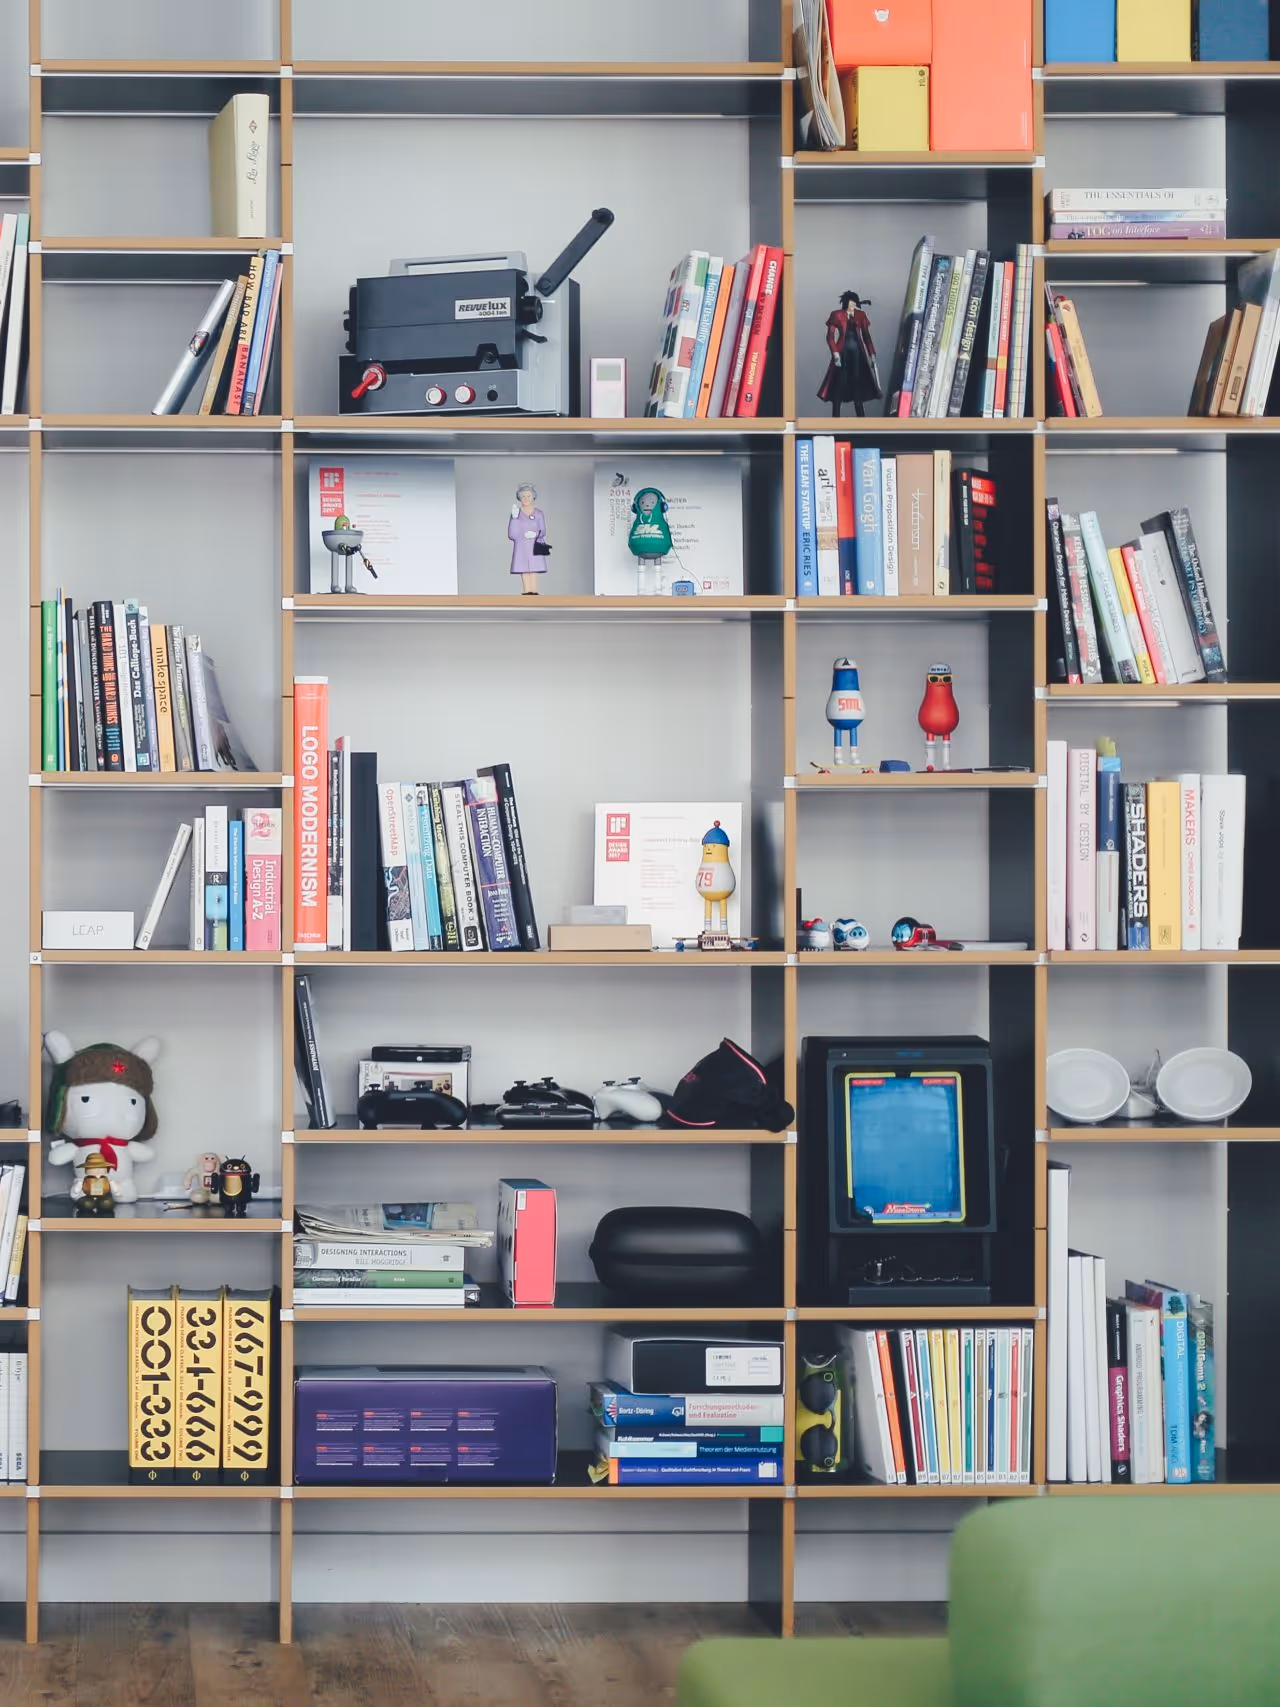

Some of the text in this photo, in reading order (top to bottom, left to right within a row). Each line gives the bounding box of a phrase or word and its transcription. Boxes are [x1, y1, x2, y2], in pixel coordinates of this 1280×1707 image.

[1084, 190, 1161, 199] THE ESSENTIALS
[246, 264, 258, 289] HOW
[765, 260, 777, 295] CHANGE
[947, 287, 958, 316] THINGS
[237, 322, 249, 342] ARE
[697, 278, 718, 343] Mobile Usability
[961, 297, 981, 351] icon design
[747, 363, 757, 385] BROWN
[609, 489, 631, 497] 2014
[818, 468, 835, 491] art
[860, 458, 878, 533] Van Gogh
[800, 444, 812, 576] THE LEAN STARTUP ERIC RIES
[884, 467, 896, 575] Value Proposition Design
[1052, 521, 1071, 635] Character Design Mobile Devices
[1187, 543, 1209, 615] The Oxford Handbook
[1187, 580, 1206, 634] PSYCHOLOGY
[90, 642, 98, 675] DUNGEON
[101, 633, 118, 724] HARD THING HARD THINGS
[127, 619, 142, 698] Das Calliope-Buch
[153, 647, 169, 713] make space
[301, 725, 318, 907] LOGO MODERNISM
[385, 788, 400, 856] OpenStreetMap
[432, 788, 445, 841] Sketching User
[476, 808, 492, 857] INTERACTION
[1079, 752, 1090, 861] DIGITAL BY DESIGN
[1185, 789, 1195, 845] MAKERS
[425, 859, 434, 879] Data
[455, 793, 473, 909] STEAL THIS COMPUTER BOOK
[487, 806, 506, 879] HUMAN-COMPUTER
[1131, 803, 1147, 918] SHADERS
[249, 859, 264, 920] Design A-Z
[264, 859, 277, 914] Industrial
[697, 871, 714, 888] 79
[72, 924, 105, 935] LEAP
[321, 1248, 408, 1257] DESIGNING INTERACTIONS
[1176, 1321, 1185, 1360] DIGITAL
[140, 1306, 172, 1462] 001-333
[185, 1306, 217, 1462] 334-666
[233, 1307, 264, 1462] 667-999
[1114, 1375, 1125, 1452] Graphics Shaders
[734, 1446, 777, 1454] Mediennutzung
